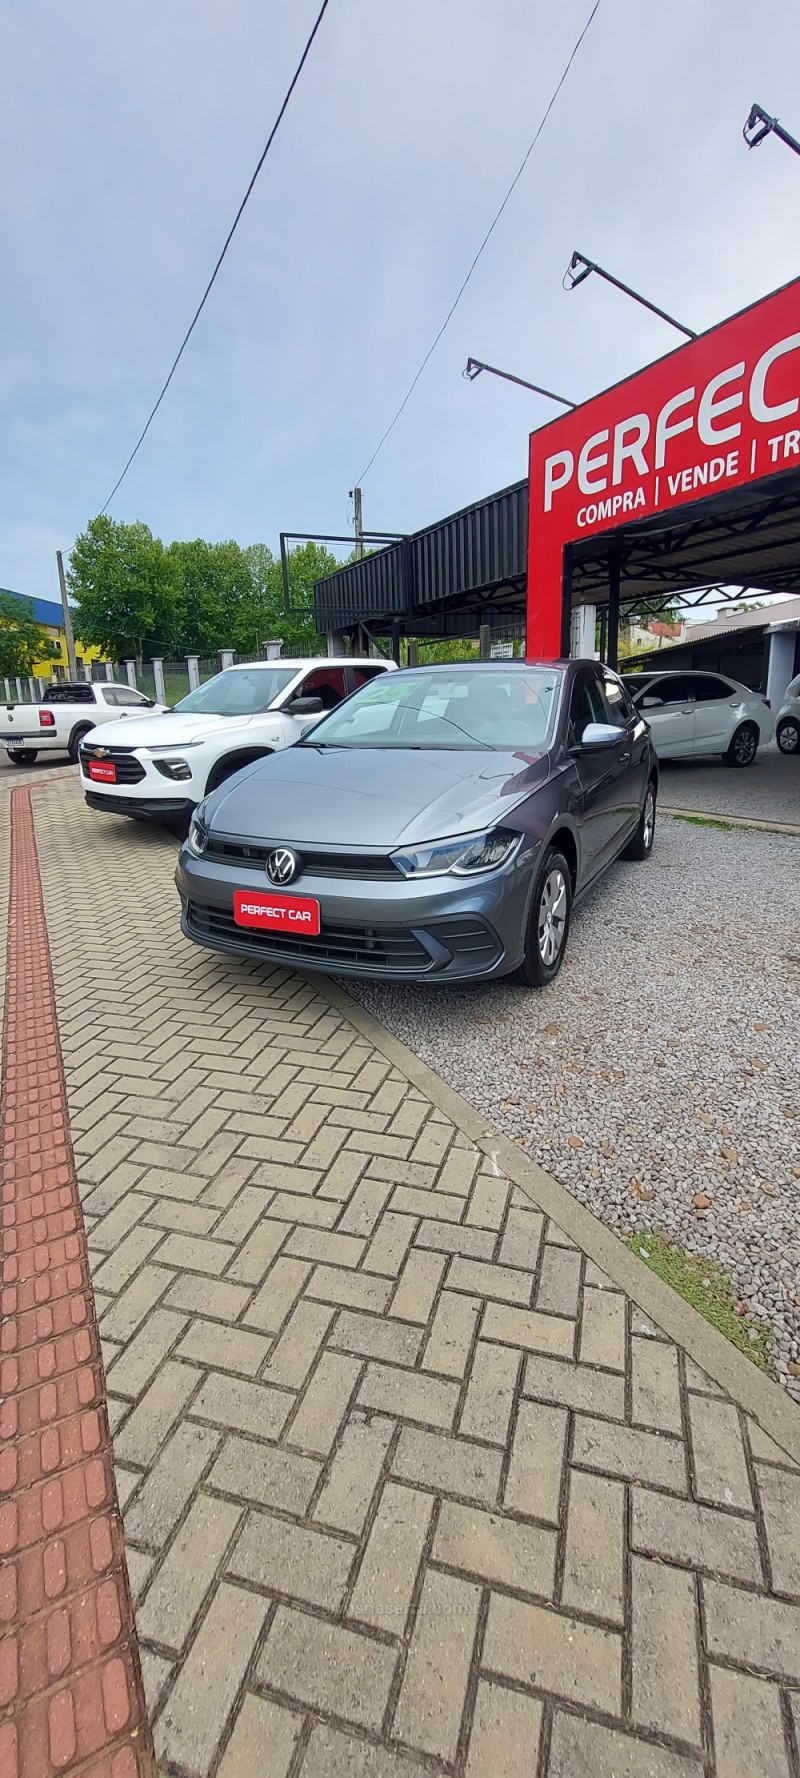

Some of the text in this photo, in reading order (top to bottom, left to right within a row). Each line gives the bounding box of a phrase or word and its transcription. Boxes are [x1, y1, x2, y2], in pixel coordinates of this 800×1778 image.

[576, 486, 646, 528] COMPRA
[667, 451, 739, 496] VENDE
[240, 903, 312, 922] PERFECT CAR
